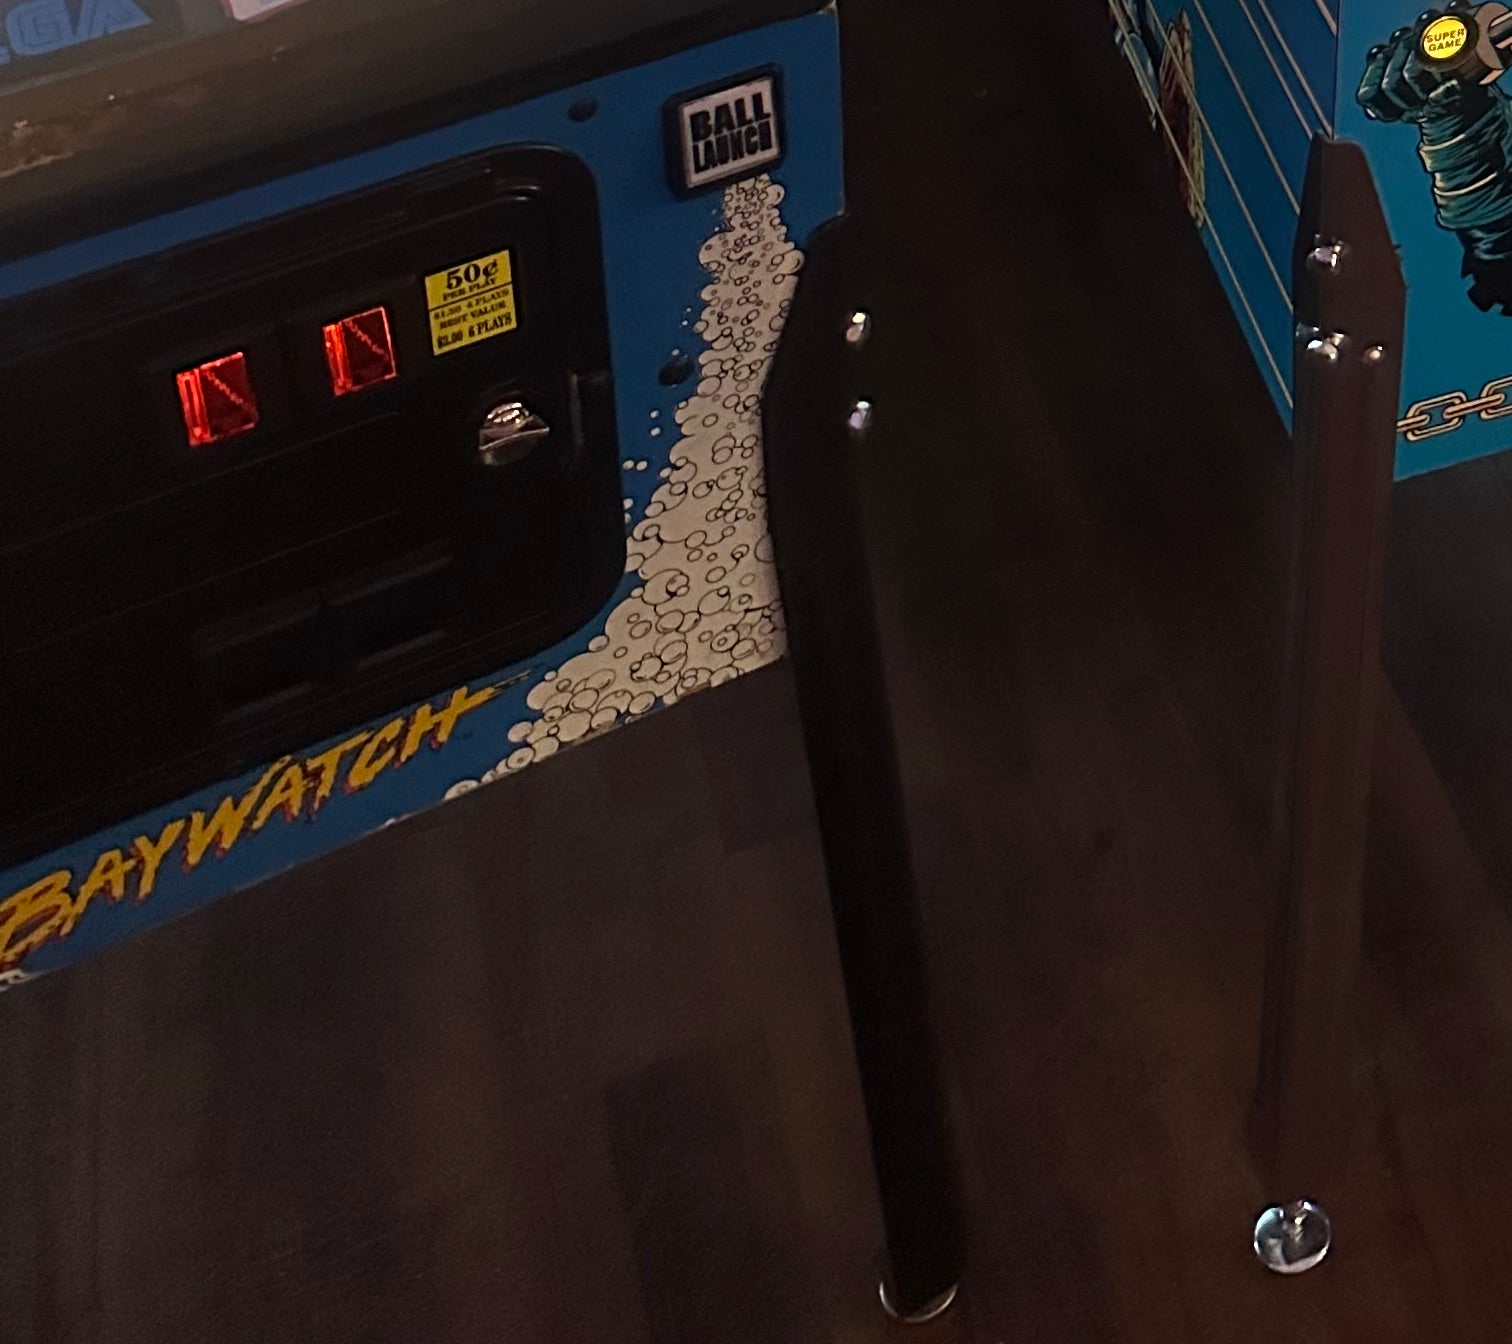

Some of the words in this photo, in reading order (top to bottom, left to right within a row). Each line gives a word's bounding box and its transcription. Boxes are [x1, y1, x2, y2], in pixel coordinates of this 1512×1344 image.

[1426, 28, 1465, 43] SUPER
[1428, 38, 1462, 52] GAME
[689, 92, 772, 142] BALL
[692, 120, 772, 173] LAUNCH
[446, 259, 499, 290] 50¢
[443, 288, 466, 301] PER
[468, 277, 497, 293] PLAY
[475, 288, 510, 306] PLAYS
[439, 314, 468, 330] BEST
[470, 300, 506, 319] VALUE
[476, 312, 513, 335] PLAYS
[0, 678, 512, 972] BAYWATCH
